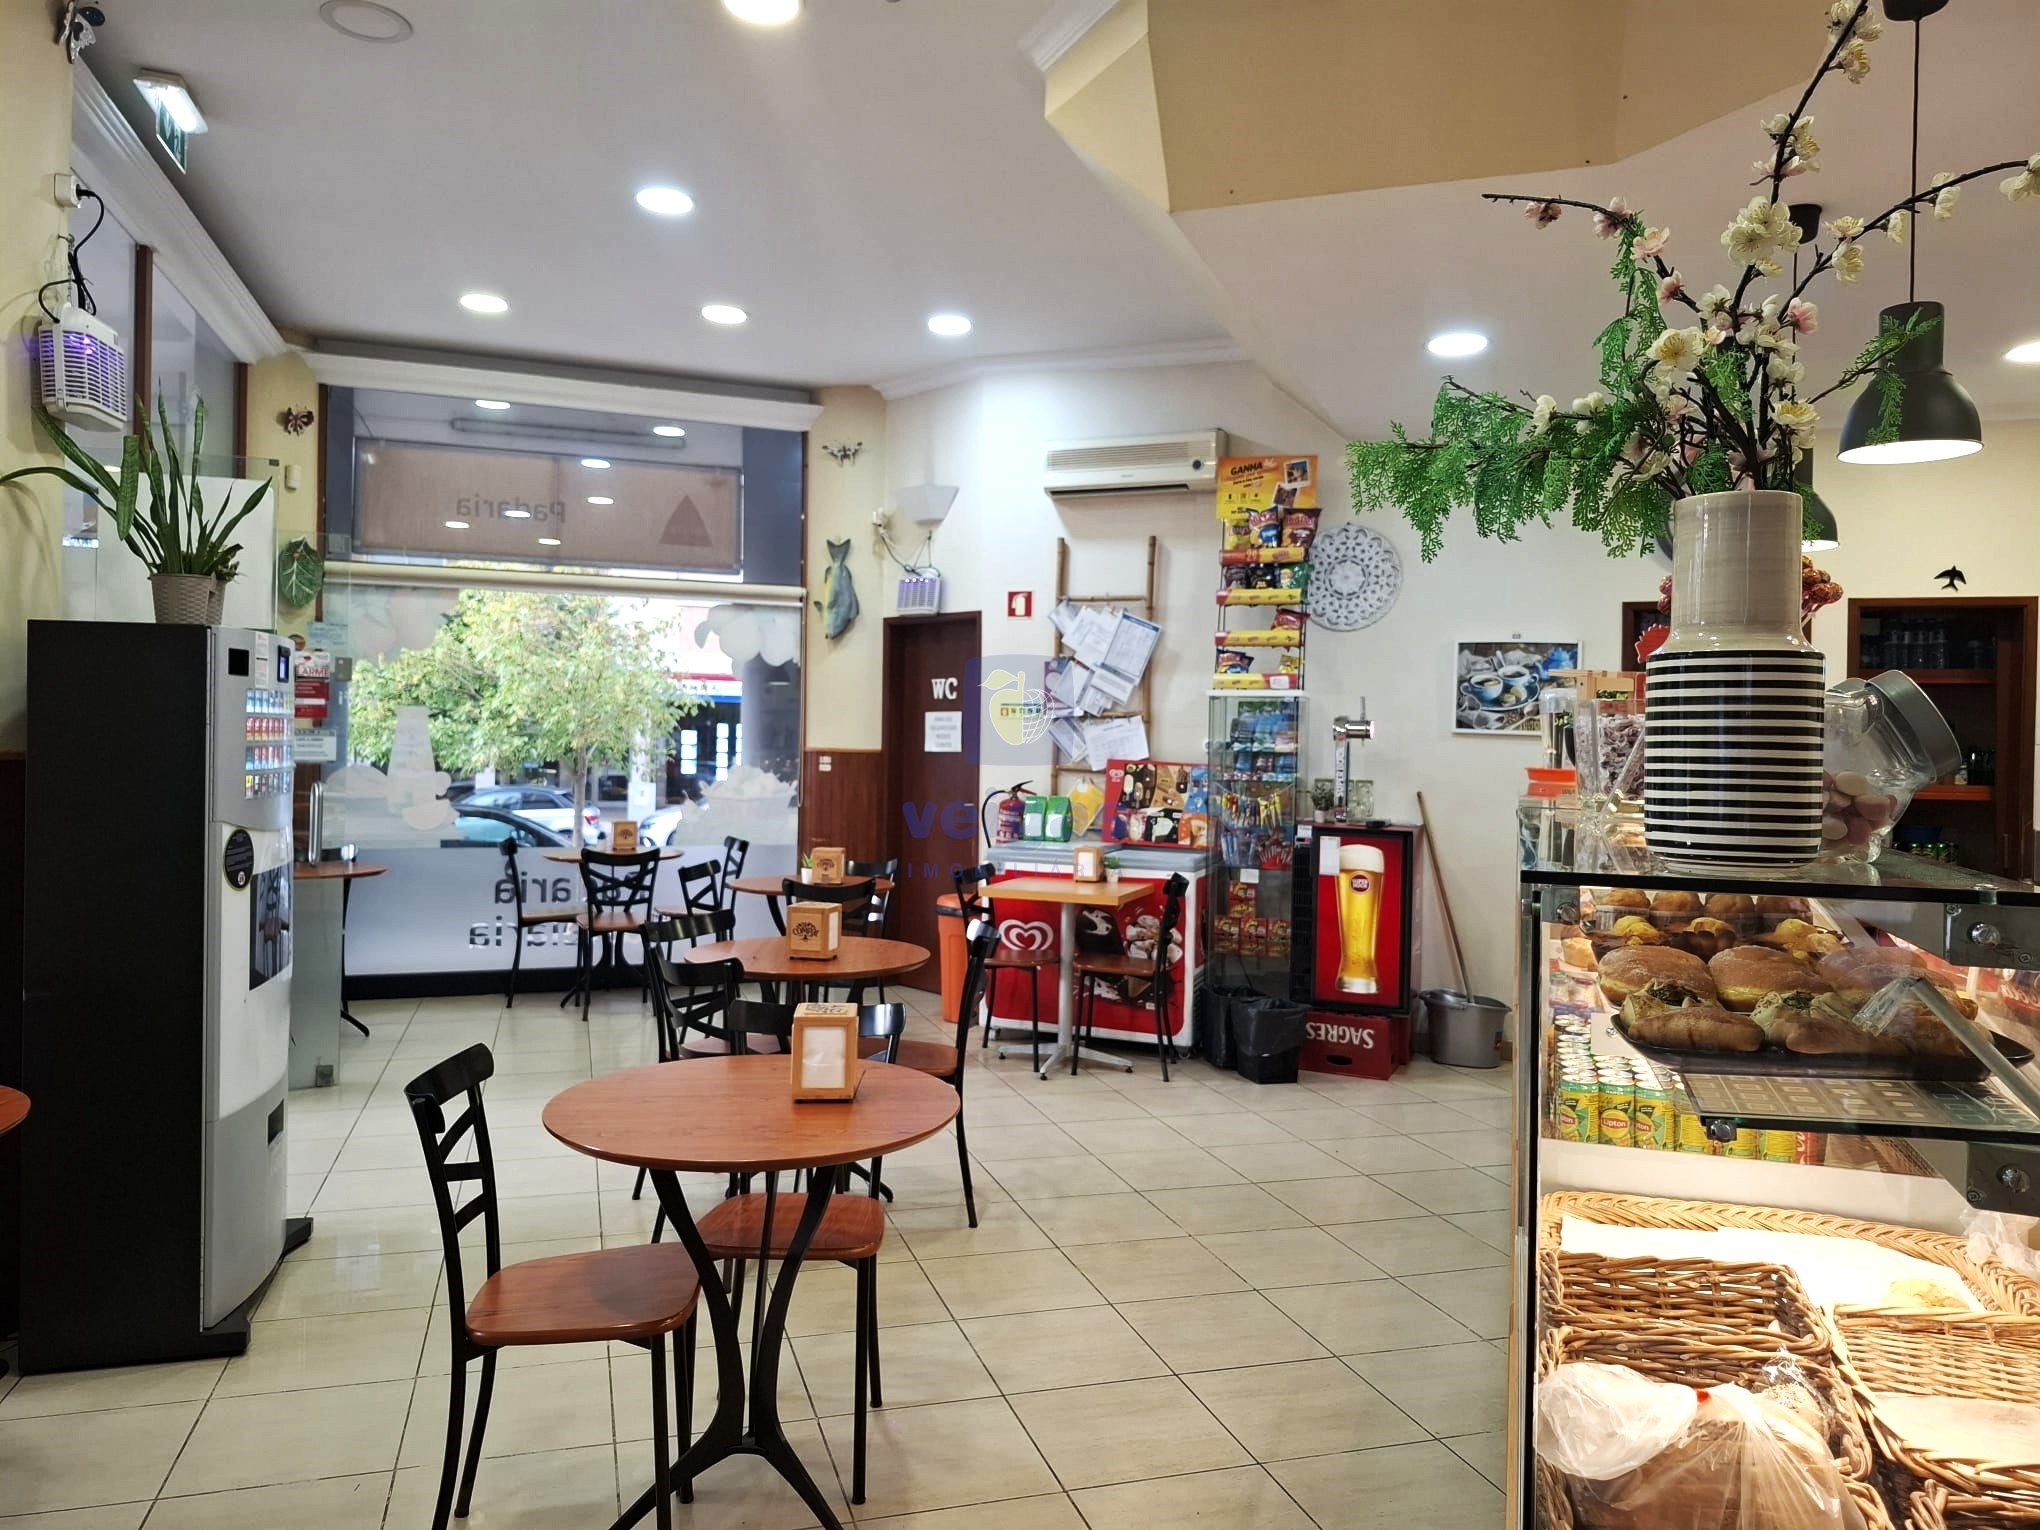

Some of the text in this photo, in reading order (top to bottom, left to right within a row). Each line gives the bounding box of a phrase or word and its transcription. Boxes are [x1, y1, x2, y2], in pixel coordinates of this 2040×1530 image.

[1231, 462, 1263, 476] GANHA
[931, 677, 959, 700] WC
[1305, 1022, 1375, 1050] SAGRES
[1603, 1118, 1626, 1128] Lipton
